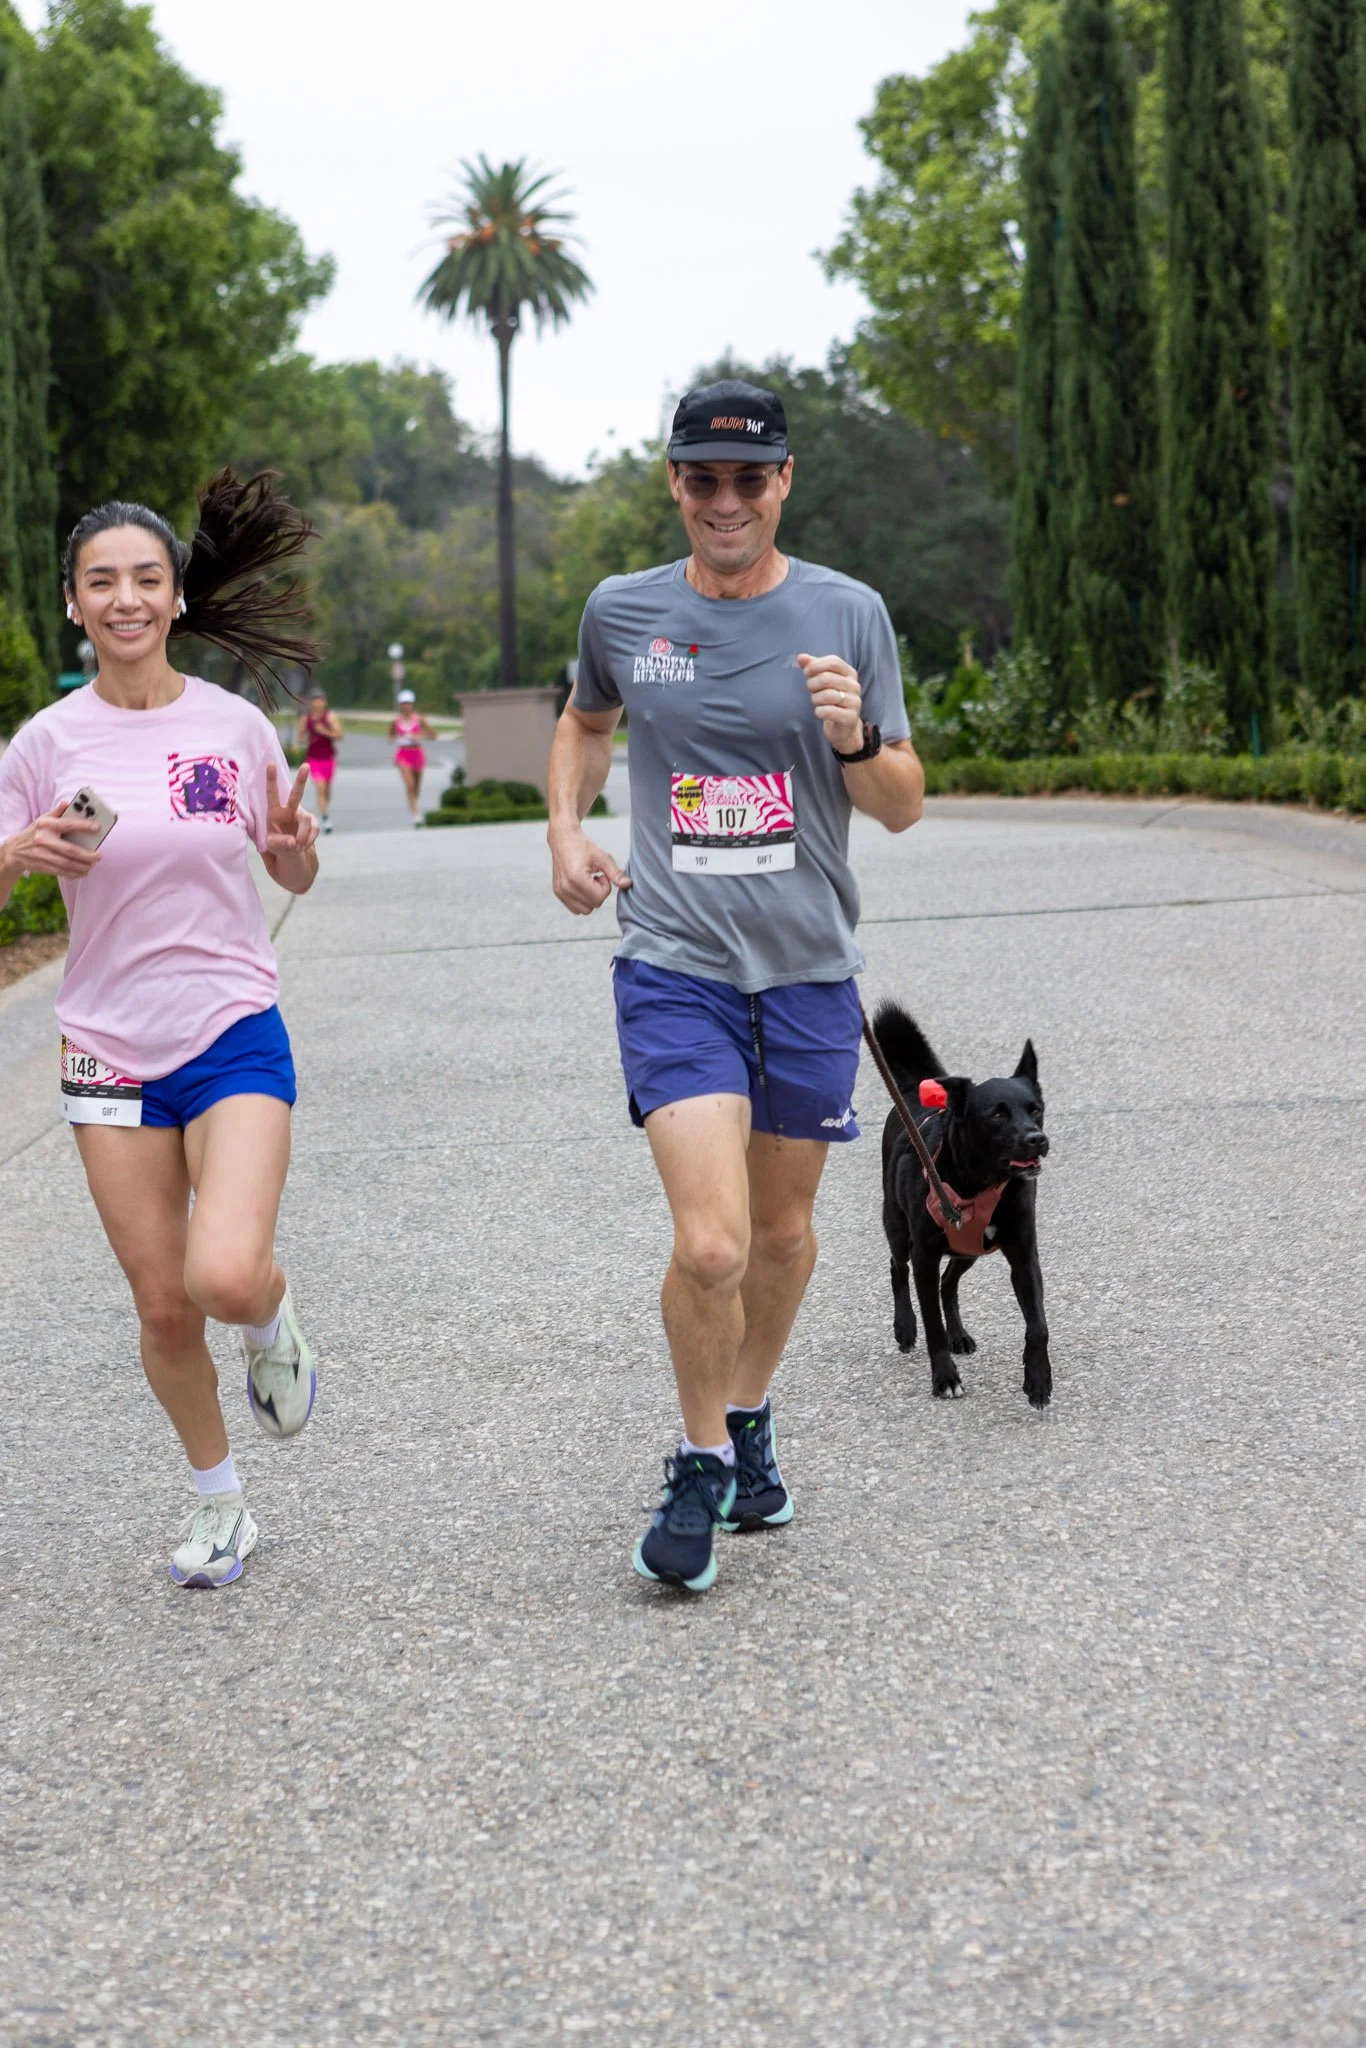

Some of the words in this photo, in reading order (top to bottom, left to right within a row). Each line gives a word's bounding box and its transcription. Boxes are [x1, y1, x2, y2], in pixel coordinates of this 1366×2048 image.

[711, 416, 745, 431] RUN
[716, 807, 747, 829] 107
[695, 855, 708, 867] 107
[757, 854, 772, 865] GIFT
[71, 1056, 97, 1078] 148
[102, 1107, 118, 1117] GIFT
